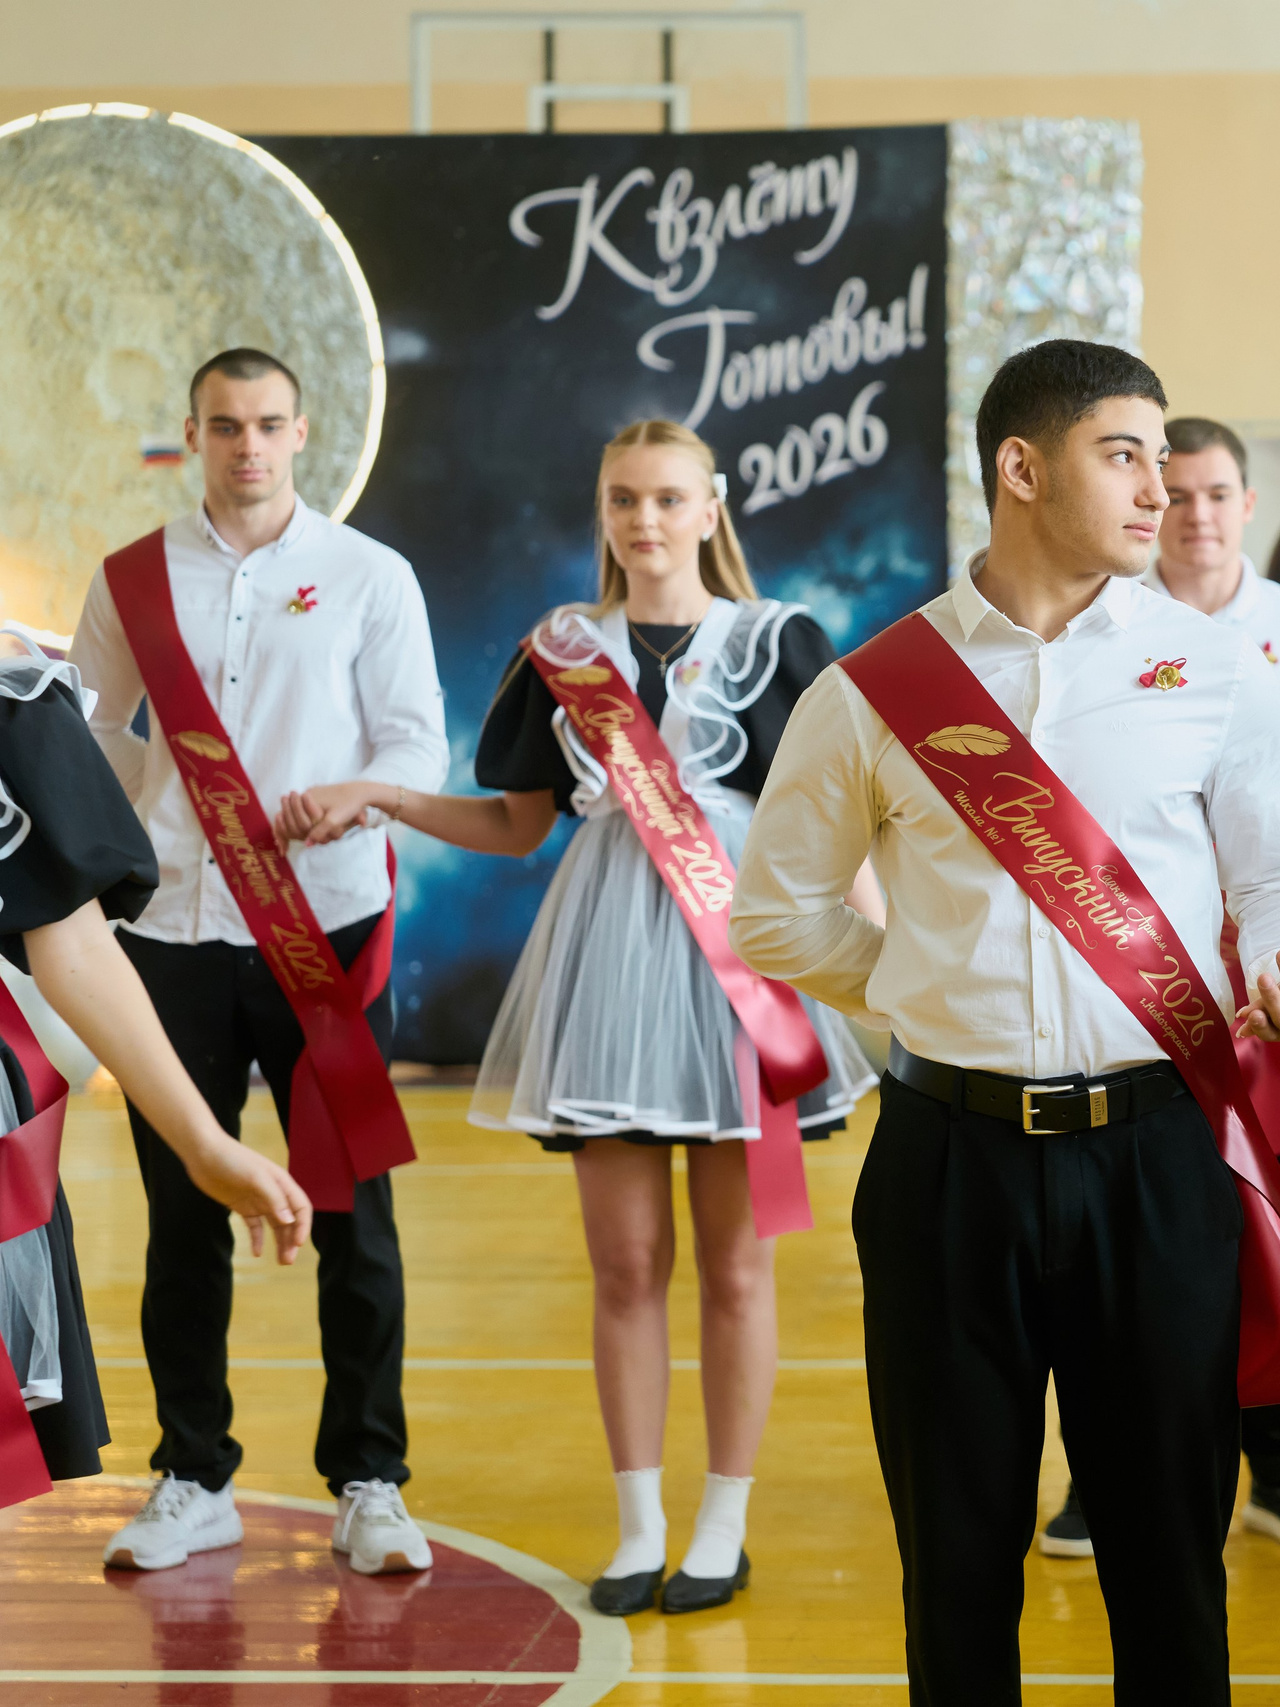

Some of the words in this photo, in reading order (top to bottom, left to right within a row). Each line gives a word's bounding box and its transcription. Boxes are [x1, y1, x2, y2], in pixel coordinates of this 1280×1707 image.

[509, 166, 660, 321] К
[738, 380, 888, 517] 2026
[953, 789, 985, 828] Школа
[984, 826, 1006, 846] №1
[982, 771, 1135, 951] Выпускник
[670, 840, 734, 913] 2026
[1091, 864, 1130, 906] Саакян
[1125, 906, 1168, 952] Артём
[269, 920, 335, 989] 2026
[1137, 954, 1215, 1047] 2026
